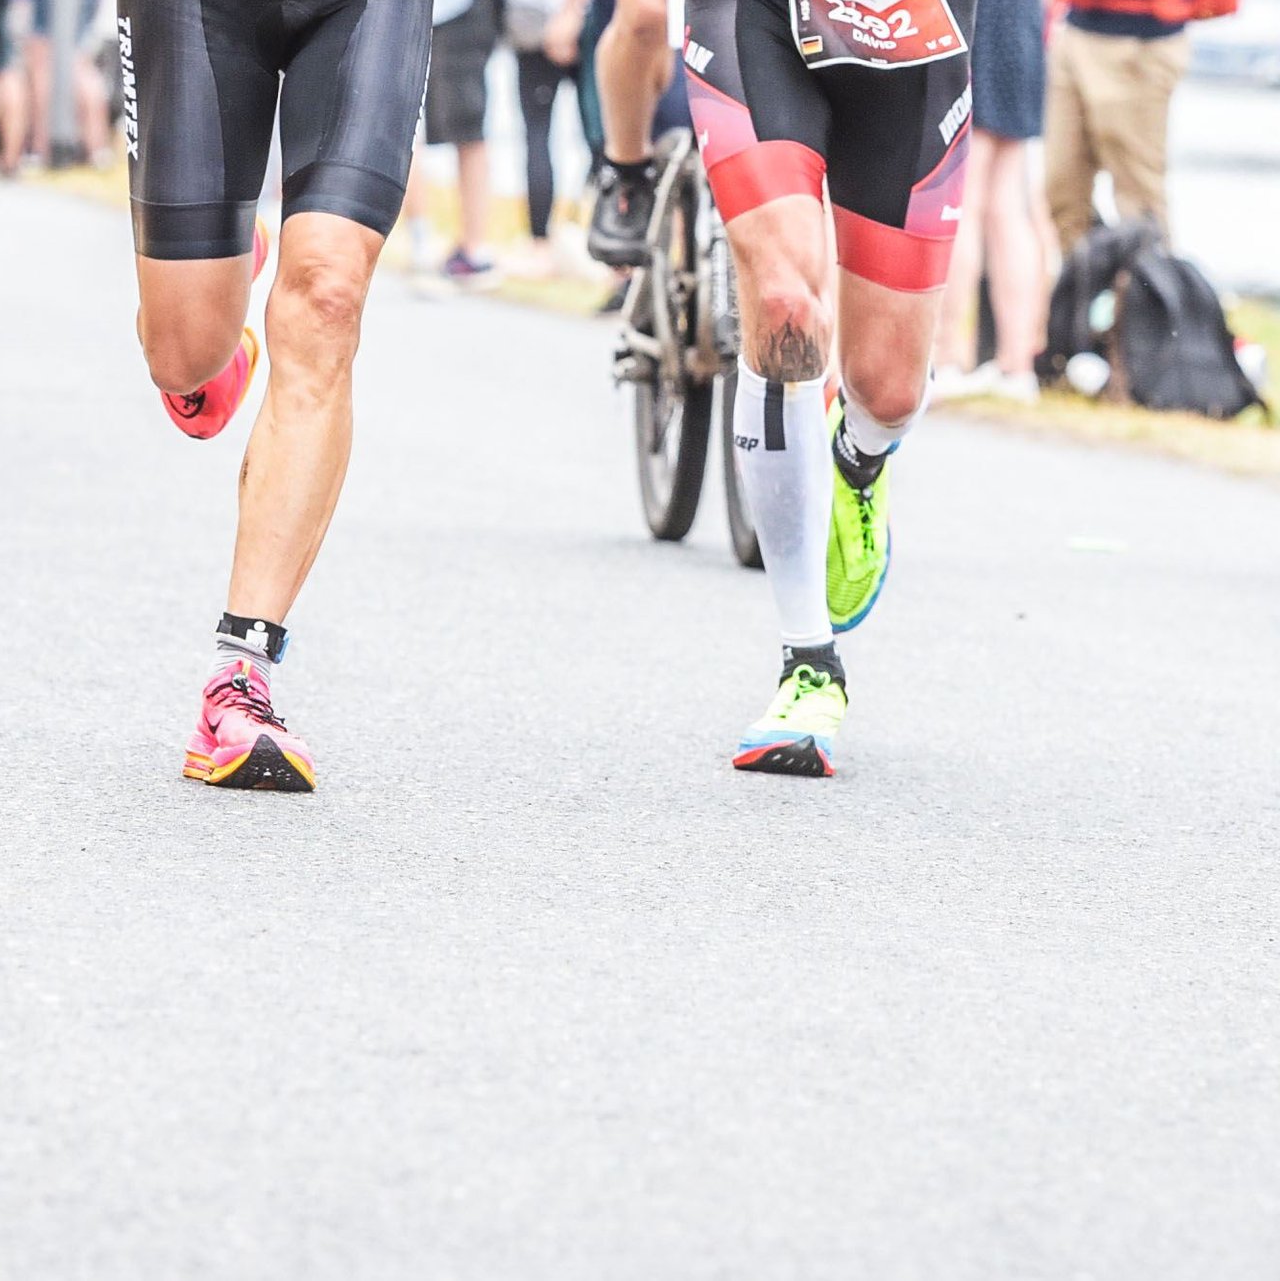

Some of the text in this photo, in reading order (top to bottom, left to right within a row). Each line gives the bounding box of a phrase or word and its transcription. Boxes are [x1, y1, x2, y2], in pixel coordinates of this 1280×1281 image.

[852, 28, 897, 50] DAVID
[118, 16, 139, 161] TRIMTEX
[735, 435, 759, 452] cep
